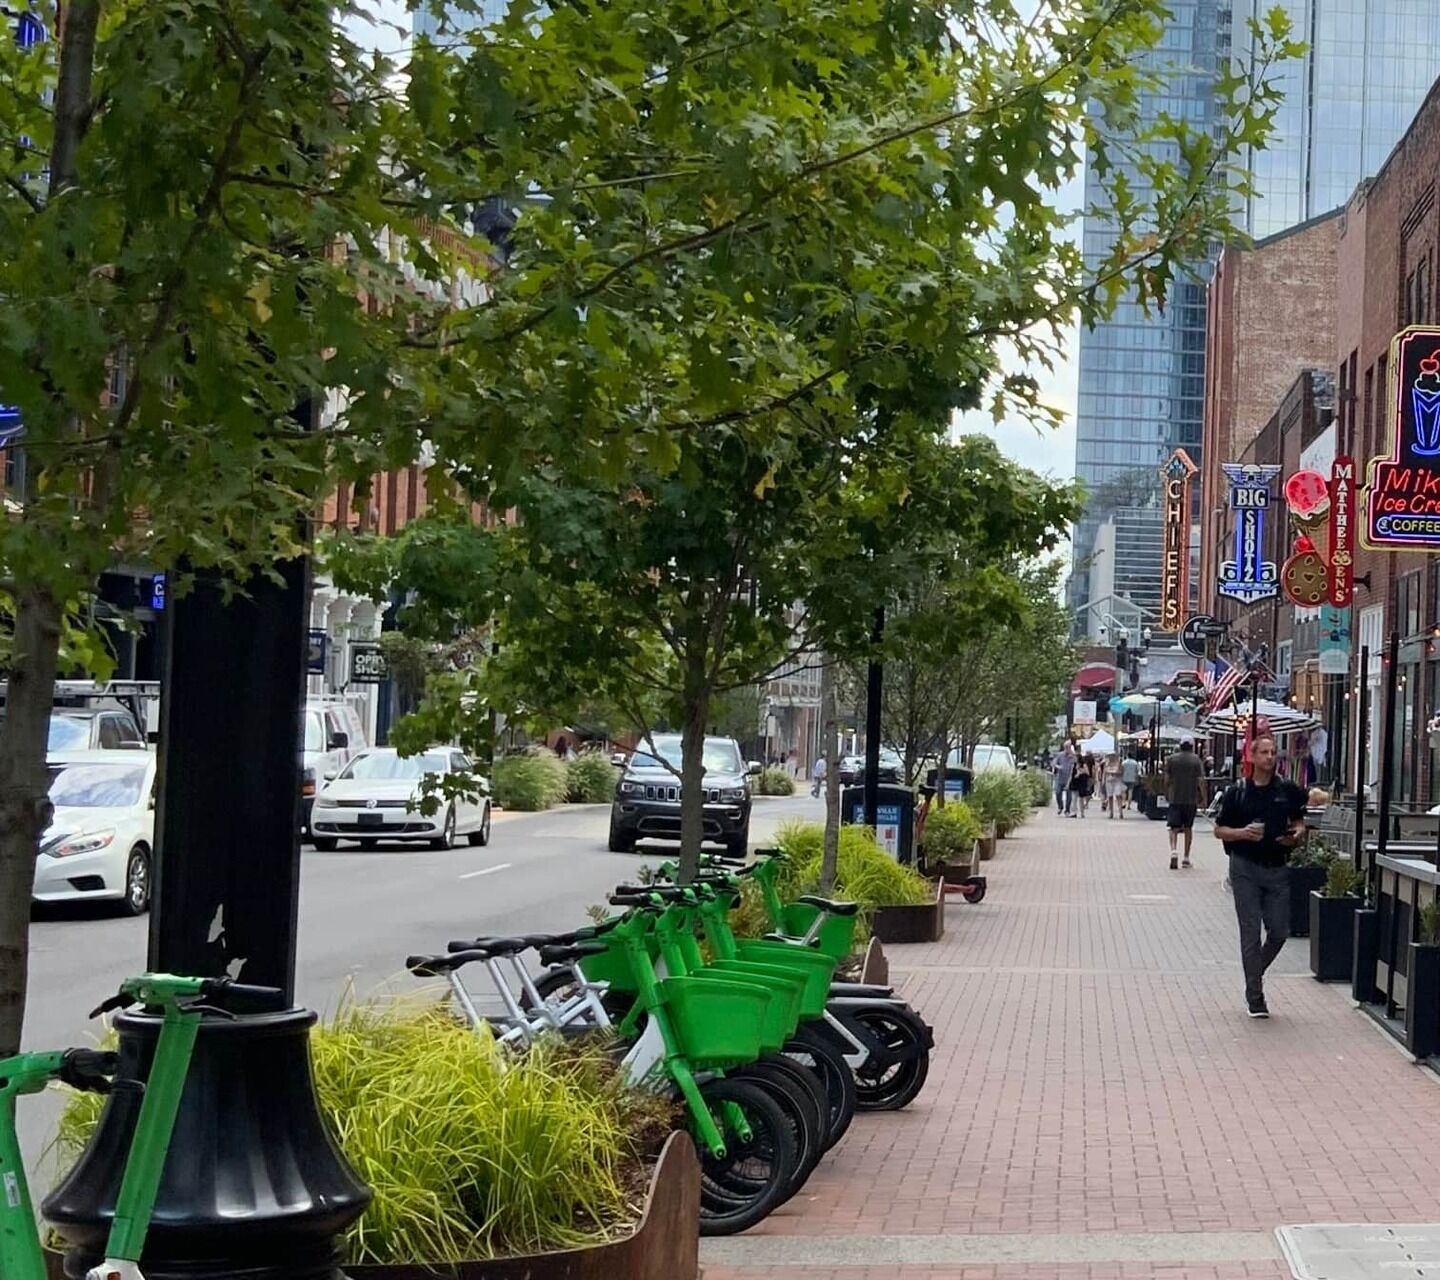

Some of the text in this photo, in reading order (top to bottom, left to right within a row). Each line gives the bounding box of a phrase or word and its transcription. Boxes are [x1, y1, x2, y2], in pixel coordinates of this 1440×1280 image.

[1236, 488, 1267, 507] BIG
[1376, 492, 1407, 512] Ice
[1165, 478, 1182, 620] CHIEFS
[1243, 509, 1256, 583] SHOTZ
